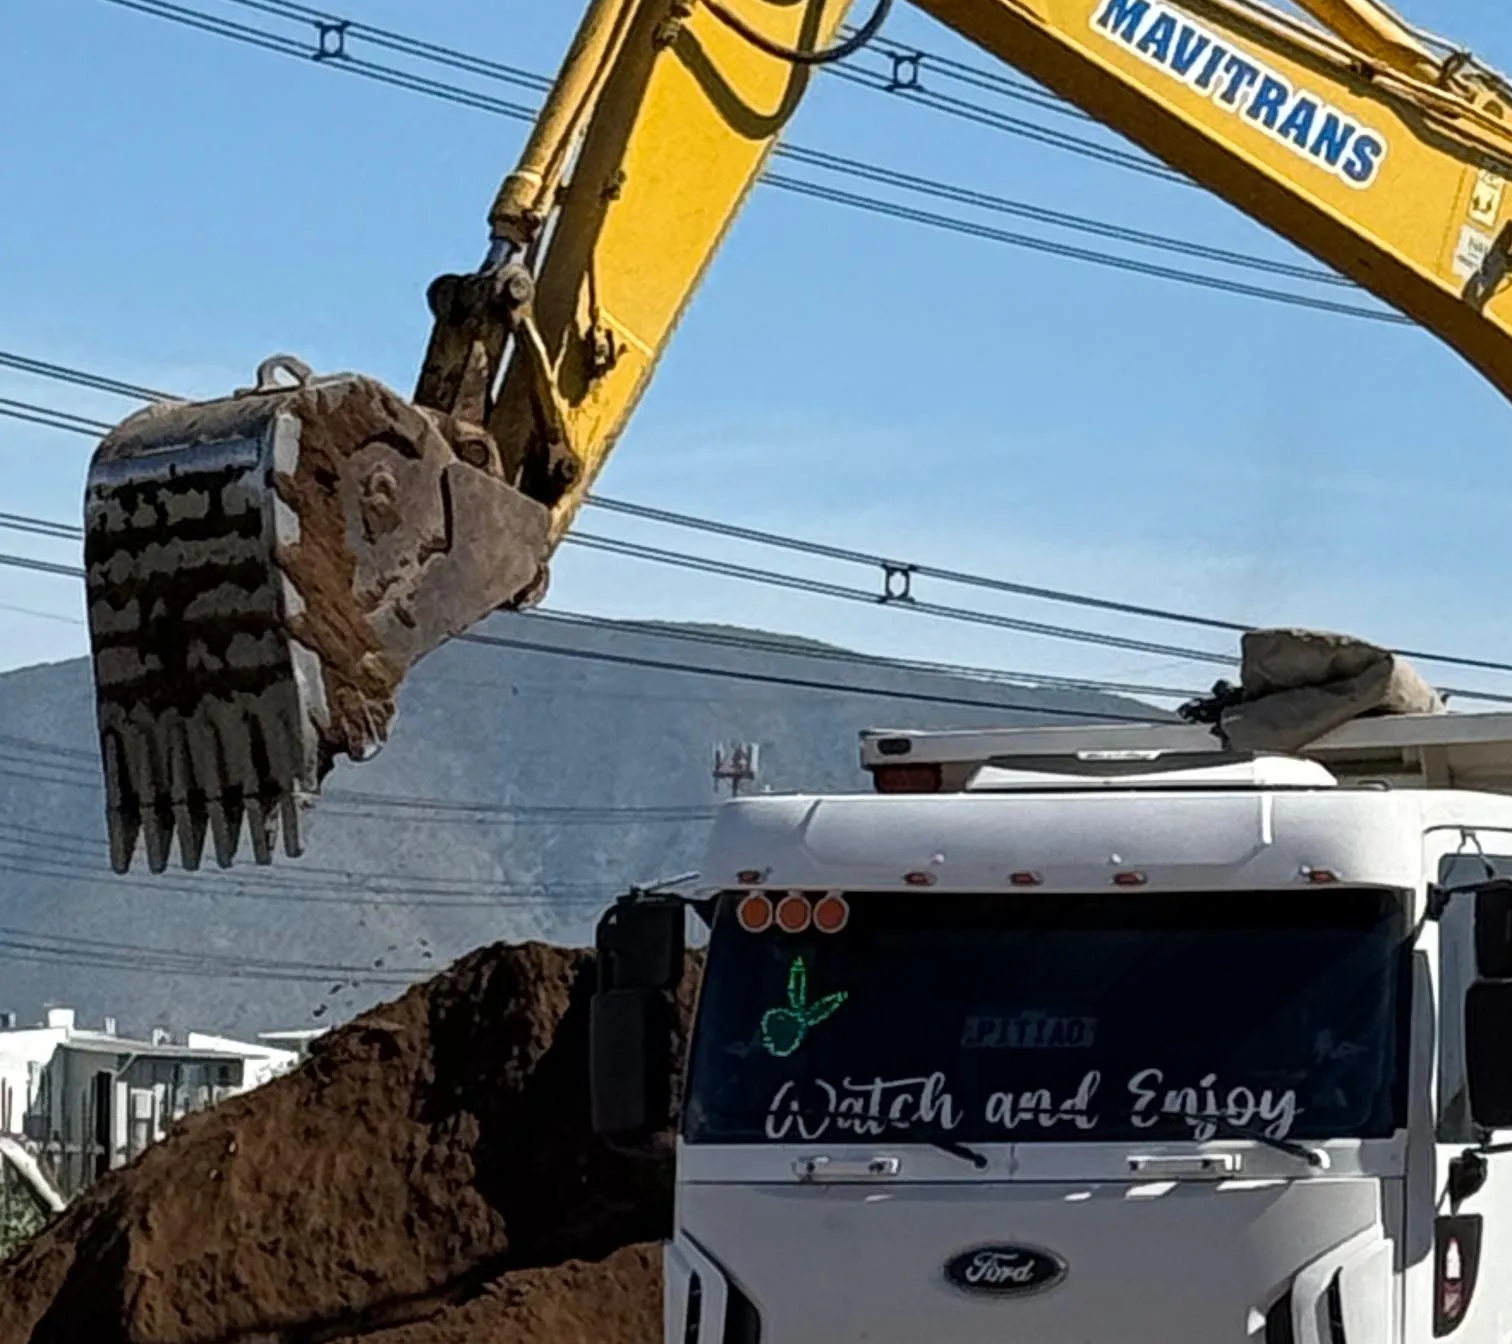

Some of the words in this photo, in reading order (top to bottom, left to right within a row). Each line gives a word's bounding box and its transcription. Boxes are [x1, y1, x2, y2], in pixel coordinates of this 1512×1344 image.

[765, 1070, 963, 1139] Watch
[985, 1070, 1101, 1129] and
[1127, 1068, 1303, 1141] Enjoy
[966, 1251, 1035, 1284] Ford
